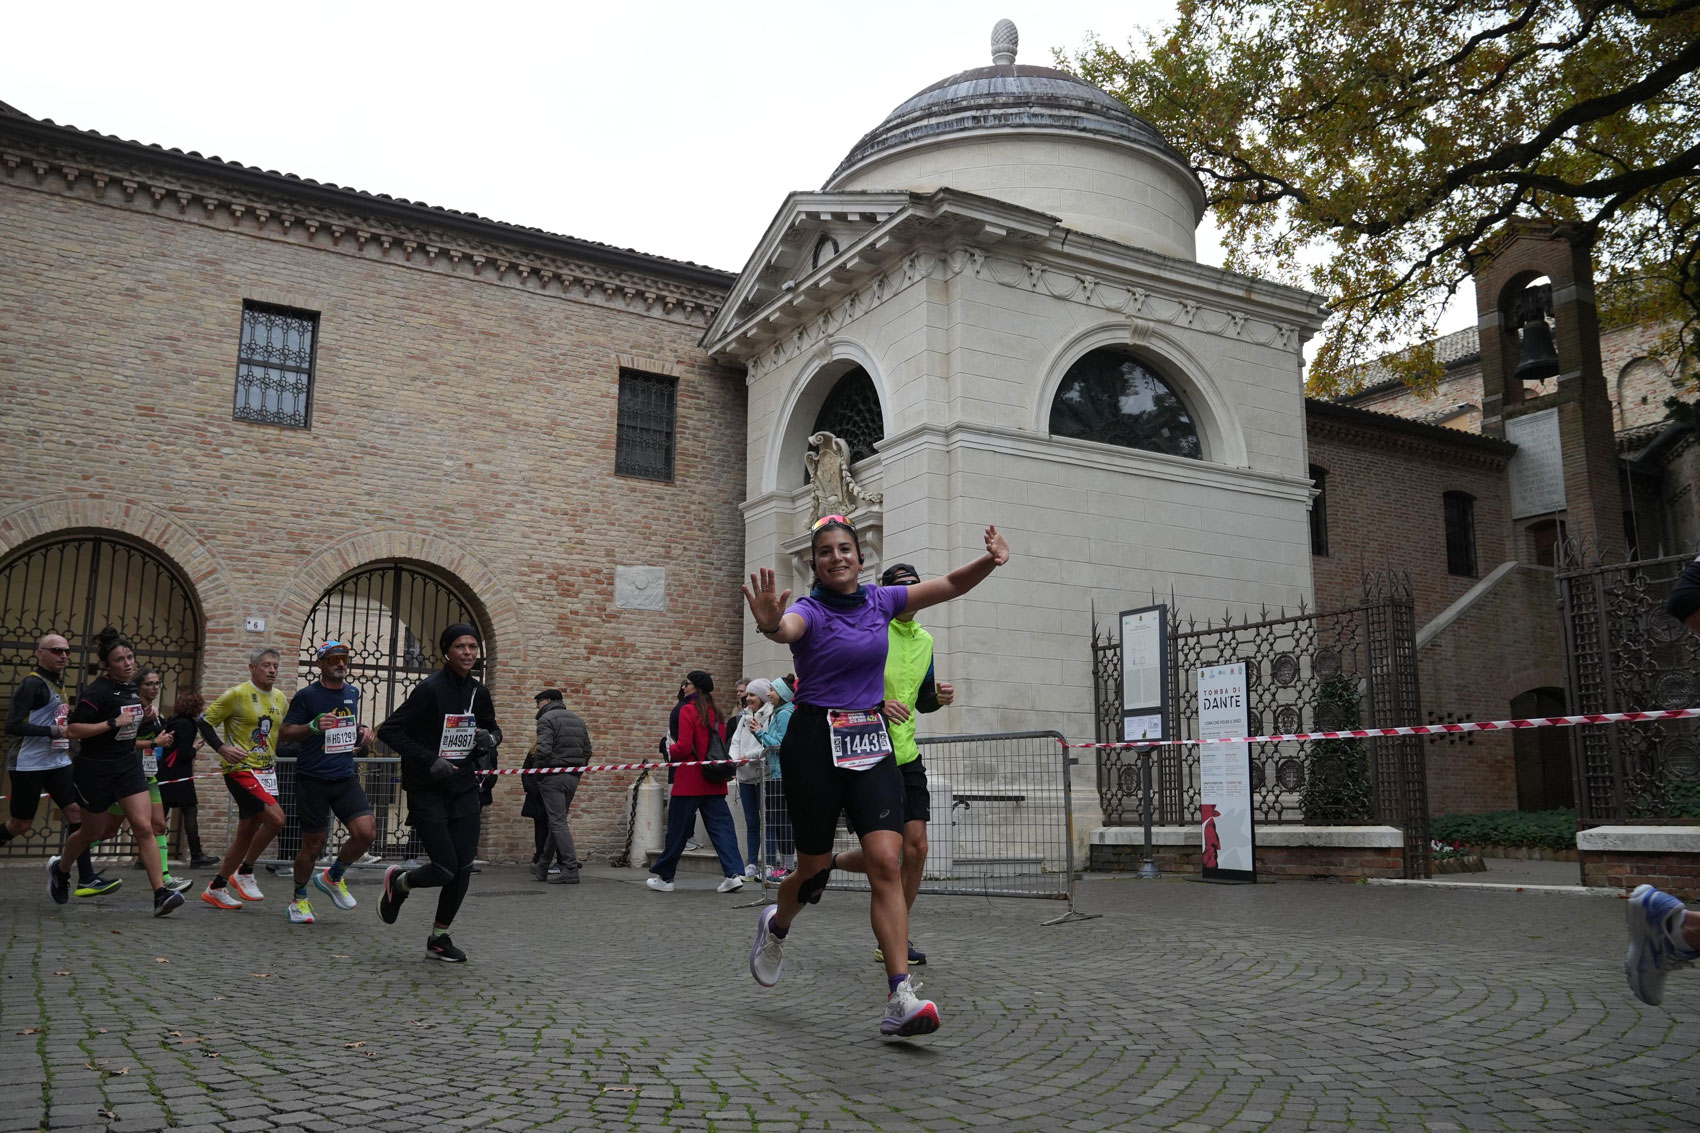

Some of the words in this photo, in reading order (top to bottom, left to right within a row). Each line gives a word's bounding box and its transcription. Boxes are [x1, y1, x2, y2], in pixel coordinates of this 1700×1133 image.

[253, 621, 259, 629] 6
[1203, 687, 1228, 697] TOMBA
[1203, 695, 1240, 710] DANTE
[332, 731, 352, 744] H6129
[447, 734, 473, 748] H4987
[844, 732, 879, 754] 1443
